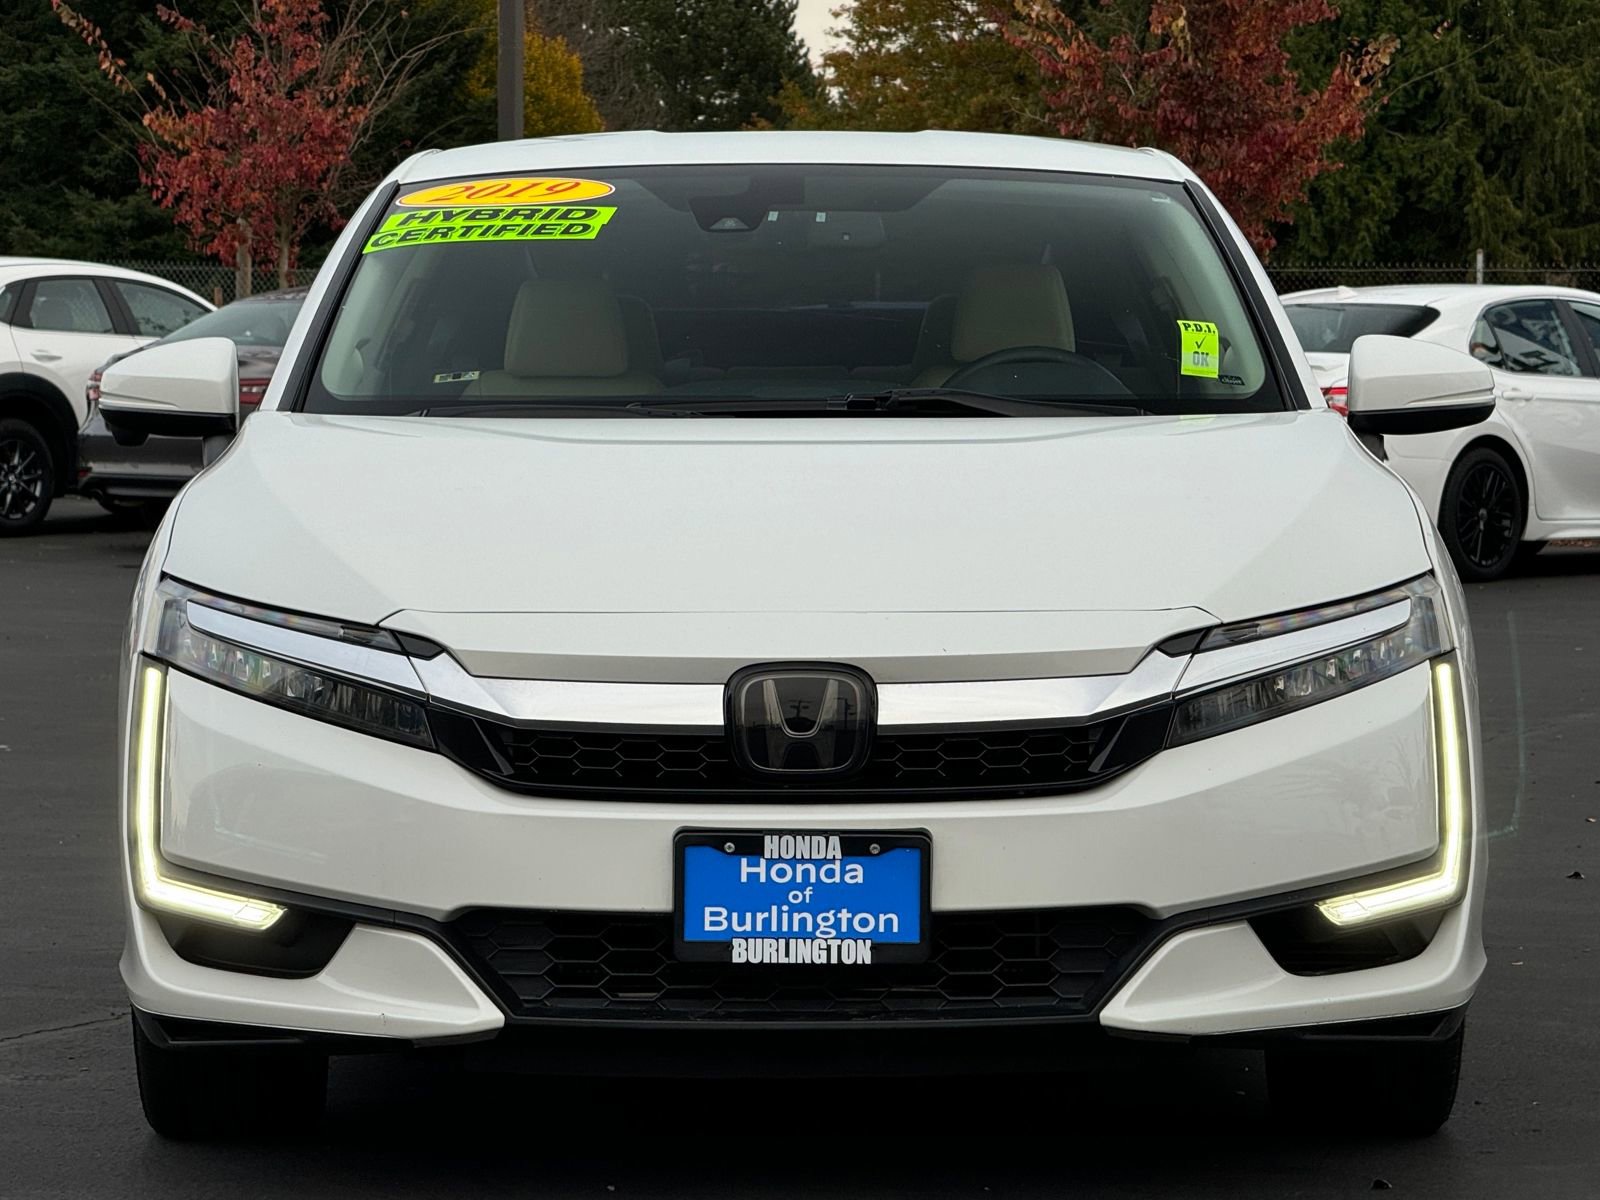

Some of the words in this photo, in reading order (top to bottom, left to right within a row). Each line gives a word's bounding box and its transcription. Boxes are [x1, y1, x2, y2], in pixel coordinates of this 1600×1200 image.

[426, 181, 581, 202] 2019
[400, 207, 601, 228] HYBRID
[370, 223, 595, 248] CERTIFIED
[1182, 322, 1216, 335] P.D.I.
[1192, 350, 1209, 367] OK
[763, 835, 842, 860] HONDA
[740, 857, 864, 884] Honda
[788, 886, 813, 904] of
[703, 904, 899, 938] Burlington
[731, 938, 872, 964] BURLINGTON
